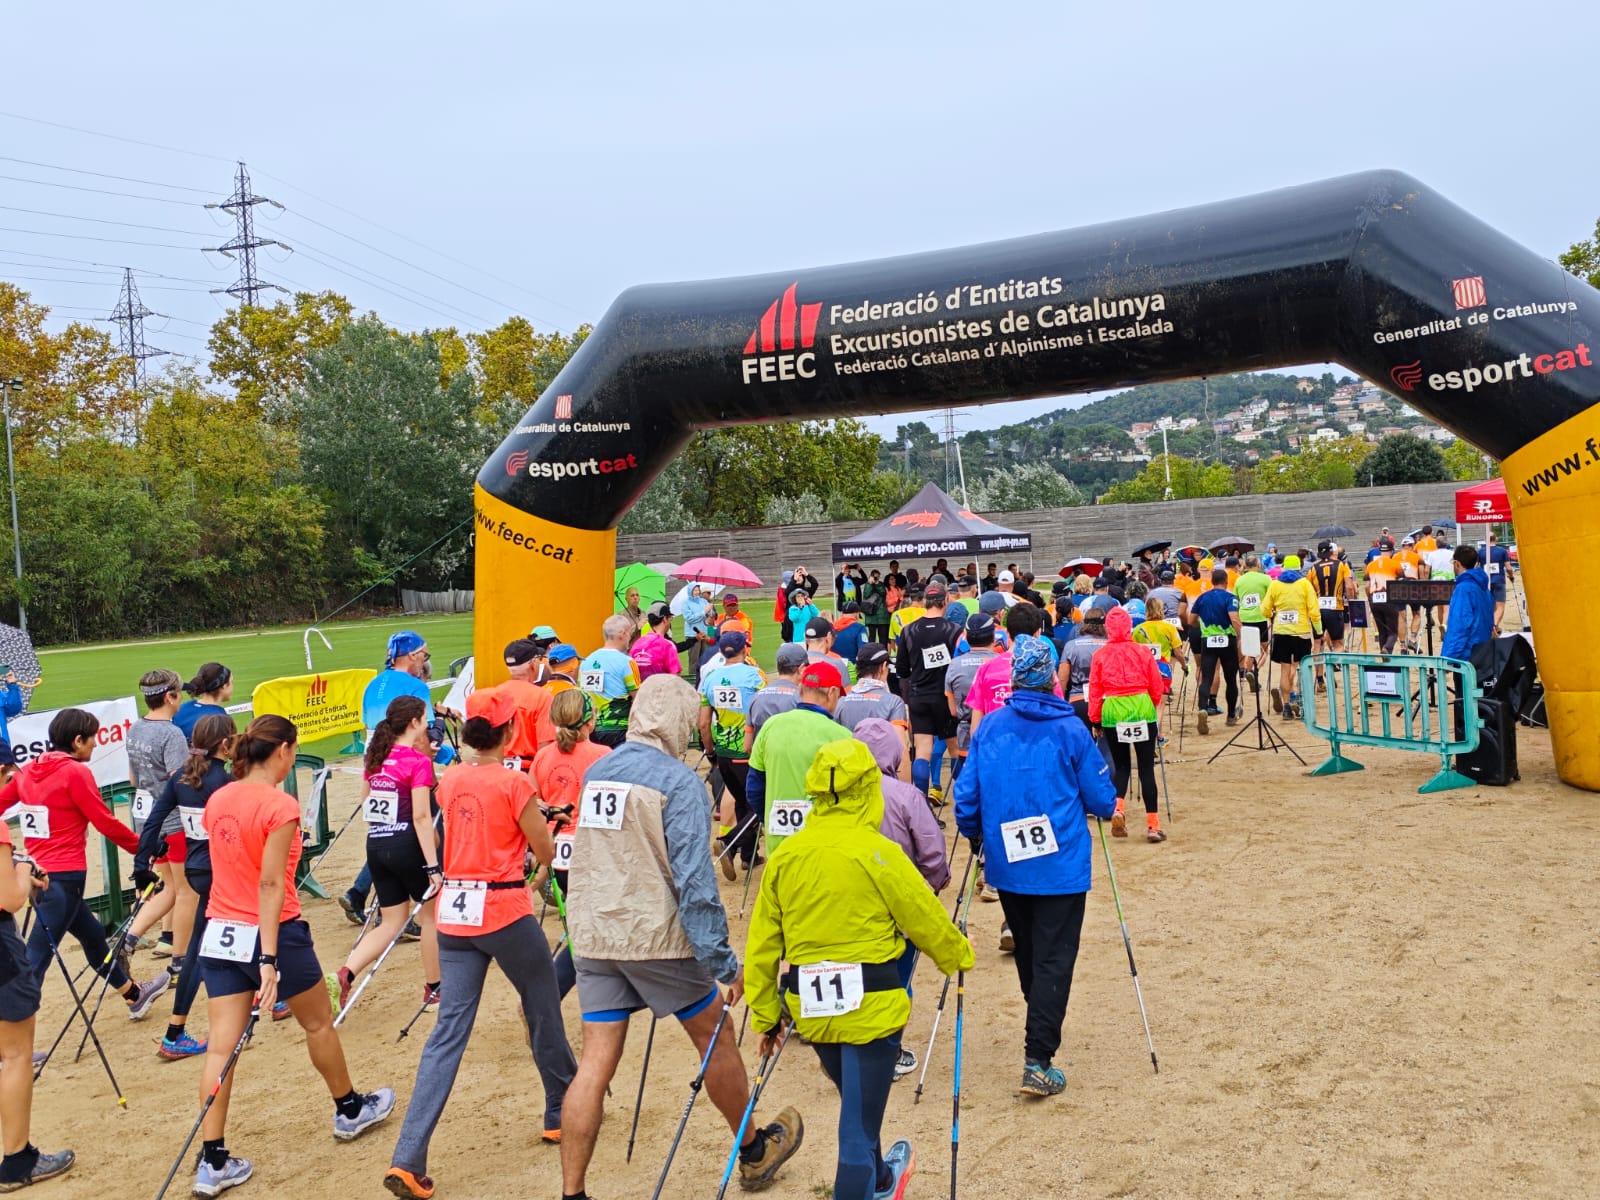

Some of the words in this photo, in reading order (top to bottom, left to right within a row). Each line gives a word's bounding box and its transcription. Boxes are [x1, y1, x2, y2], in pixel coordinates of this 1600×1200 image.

[830, 294, 938, 326] Federació
[831, 319, 993, 356] Excursionistes
[1000, 310, 1031, 334] de
[1037, 293, 1167, 329] Catalunya
[1373, 315, 1463, 344] Generalitat
[1467, 311, 1489, 326] de
[1492, 300, 1578, 321] Catalunya
[834, 353, 908, 376] Federació
[911, 347, 981, 367] Catalana
[1088, 330, 1095, 344] i
[1098, 318, 1175, 344] Escalada
[741, 352, 817, 385] FEEC
[1428, 342, 1593, 393] esportcat
[559, 421, 572, 433] de
[573, 420, 631, 434] Catalunya
[528, 453, 637, 481] esportcat
[842, 539, 968, 557] www.sphere-pro.com
[928, 650, 945, 663] 28
[586, 675, 600, 686] 24
[306, 695, 327, 708] FEEC
[719, 691, 738, 703] 32
[330, 710, 359, 722] Catalunya
[1122, 726, 1143, 738] 45
[136, 796, 143, 811] 6
[369, 798, 390, 816] 22
[592, 791, 617, 816] 13
[25, 813, 37, 829] 2
[187, 815, 194, 831] 1
[776, 809, 803, 827] 30
[1015, 825, 1047, 849] 18
[452, 891, 467, 913] 4
[219, 926, 236, 948] 5
[810, 973, 844, 1002] 11
